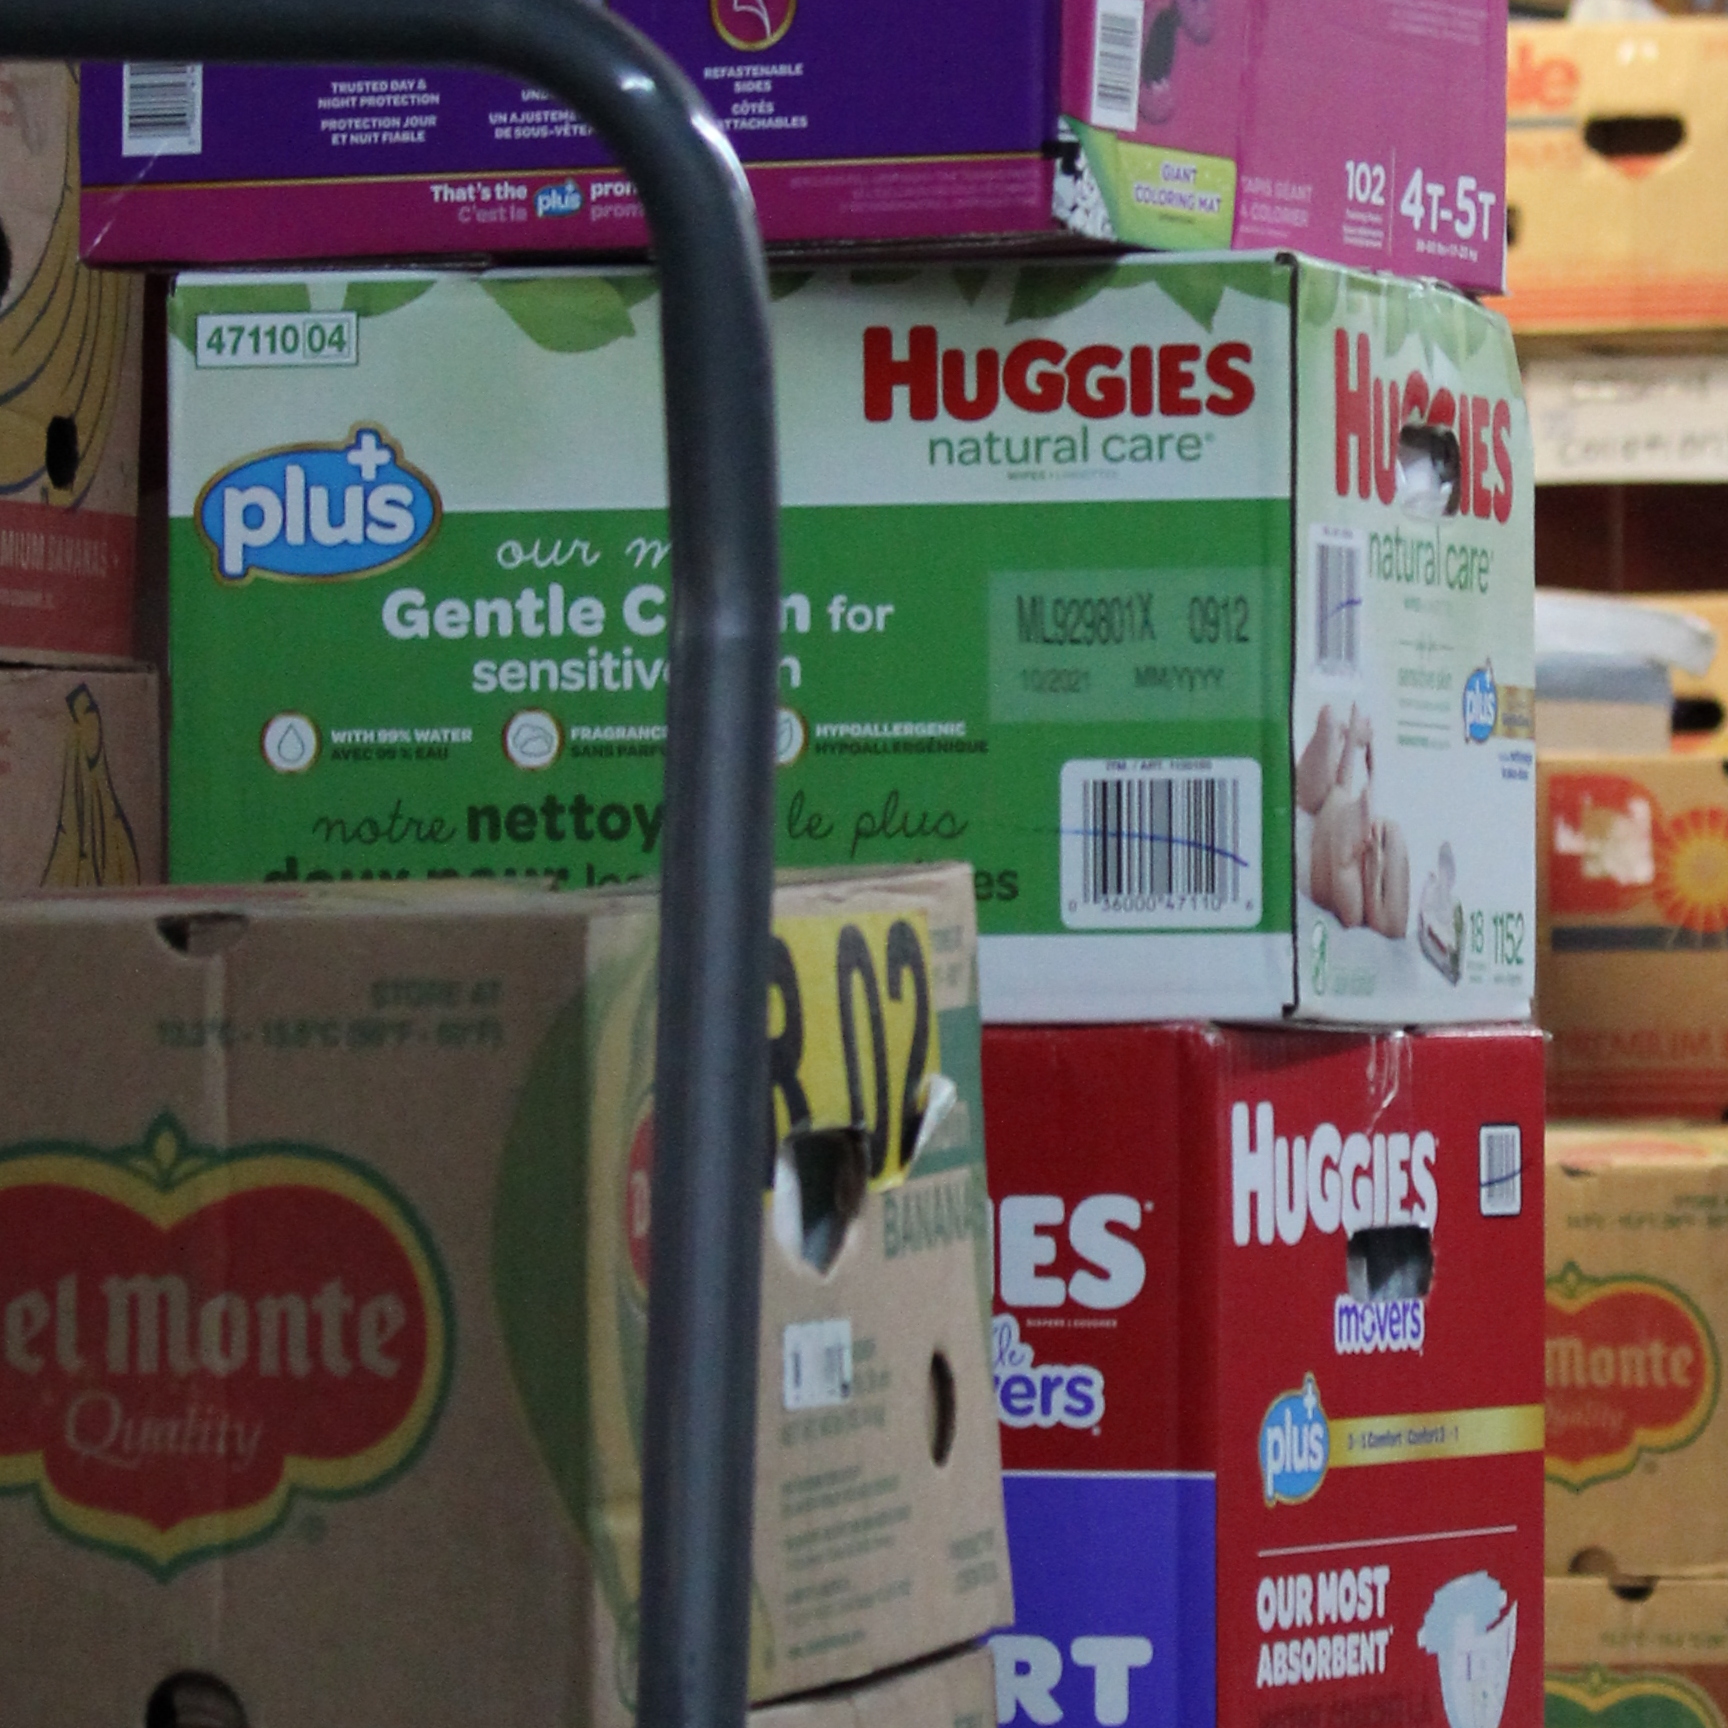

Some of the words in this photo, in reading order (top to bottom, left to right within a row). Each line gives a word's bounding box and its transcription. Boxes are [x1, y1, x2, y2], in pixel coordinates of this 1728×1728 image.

[704, 62, 804, 79] REFASTENABLE
[734, 79, 772, 94] SIDES
[318, 96, 356, 109] NIGHT
[359, 94, 440, 108] PROTECTION
[331, 80, 388, 94] TRUSTED
[321, 117, 400, 131] PROTECTION
[403, 115, 437, 129] JOUR
[489, 113, 507, 124] UN
[495, 128, 512, 140] DE
[719, 115, 809, 132] TTACHABLES
[331, 134, 347, 146] ET
[349, 133, 379, 145] NUIT
[382, 130, 425, 144] FIABLE
[1161, 160, 1197, 185] GIANT
[1344, 158, 1386, 207] 102
[430, 184, 482, 203] That's
[495, 181, 527, 200] the
[1133, 183, 1196, 210] COLORING
[1198, 194, 1222, 214] MAT
[863, 325, 1255, 422] HUGGIES
[928, 425, 1091, 466] natural
[1102, 432, 1204, 463] care
[496, 536, 601, 570] our
[1369, 525, 1441, 586] natural
[1446, 543, 1490, 594] care
[382, 581, 606, 640] Gentle
[828, 594, 895, 633] for
[331, 728, 376, 744] WITH
[414, 727, 473, 743] WATER
[816, 722, 967, 738] HYPOALLERGENIC
[312, 797, 456, 846] notre
[467, 792, 665, 854] nettoy
[1492, 910, 1525, 966] 1152
[1231, 1101, 1438, 1248] HUGGIES
[0, 1284, 83, 1378] el
[104, 1270, 408, 1382] Monte
[1337, 1298, 1423, 1345] movers
[63, 1389, 267, 1464] Quality
[1256, 1573, 1314, 1633] OUR
[1317, 1565, 1391, 1626] MOST
